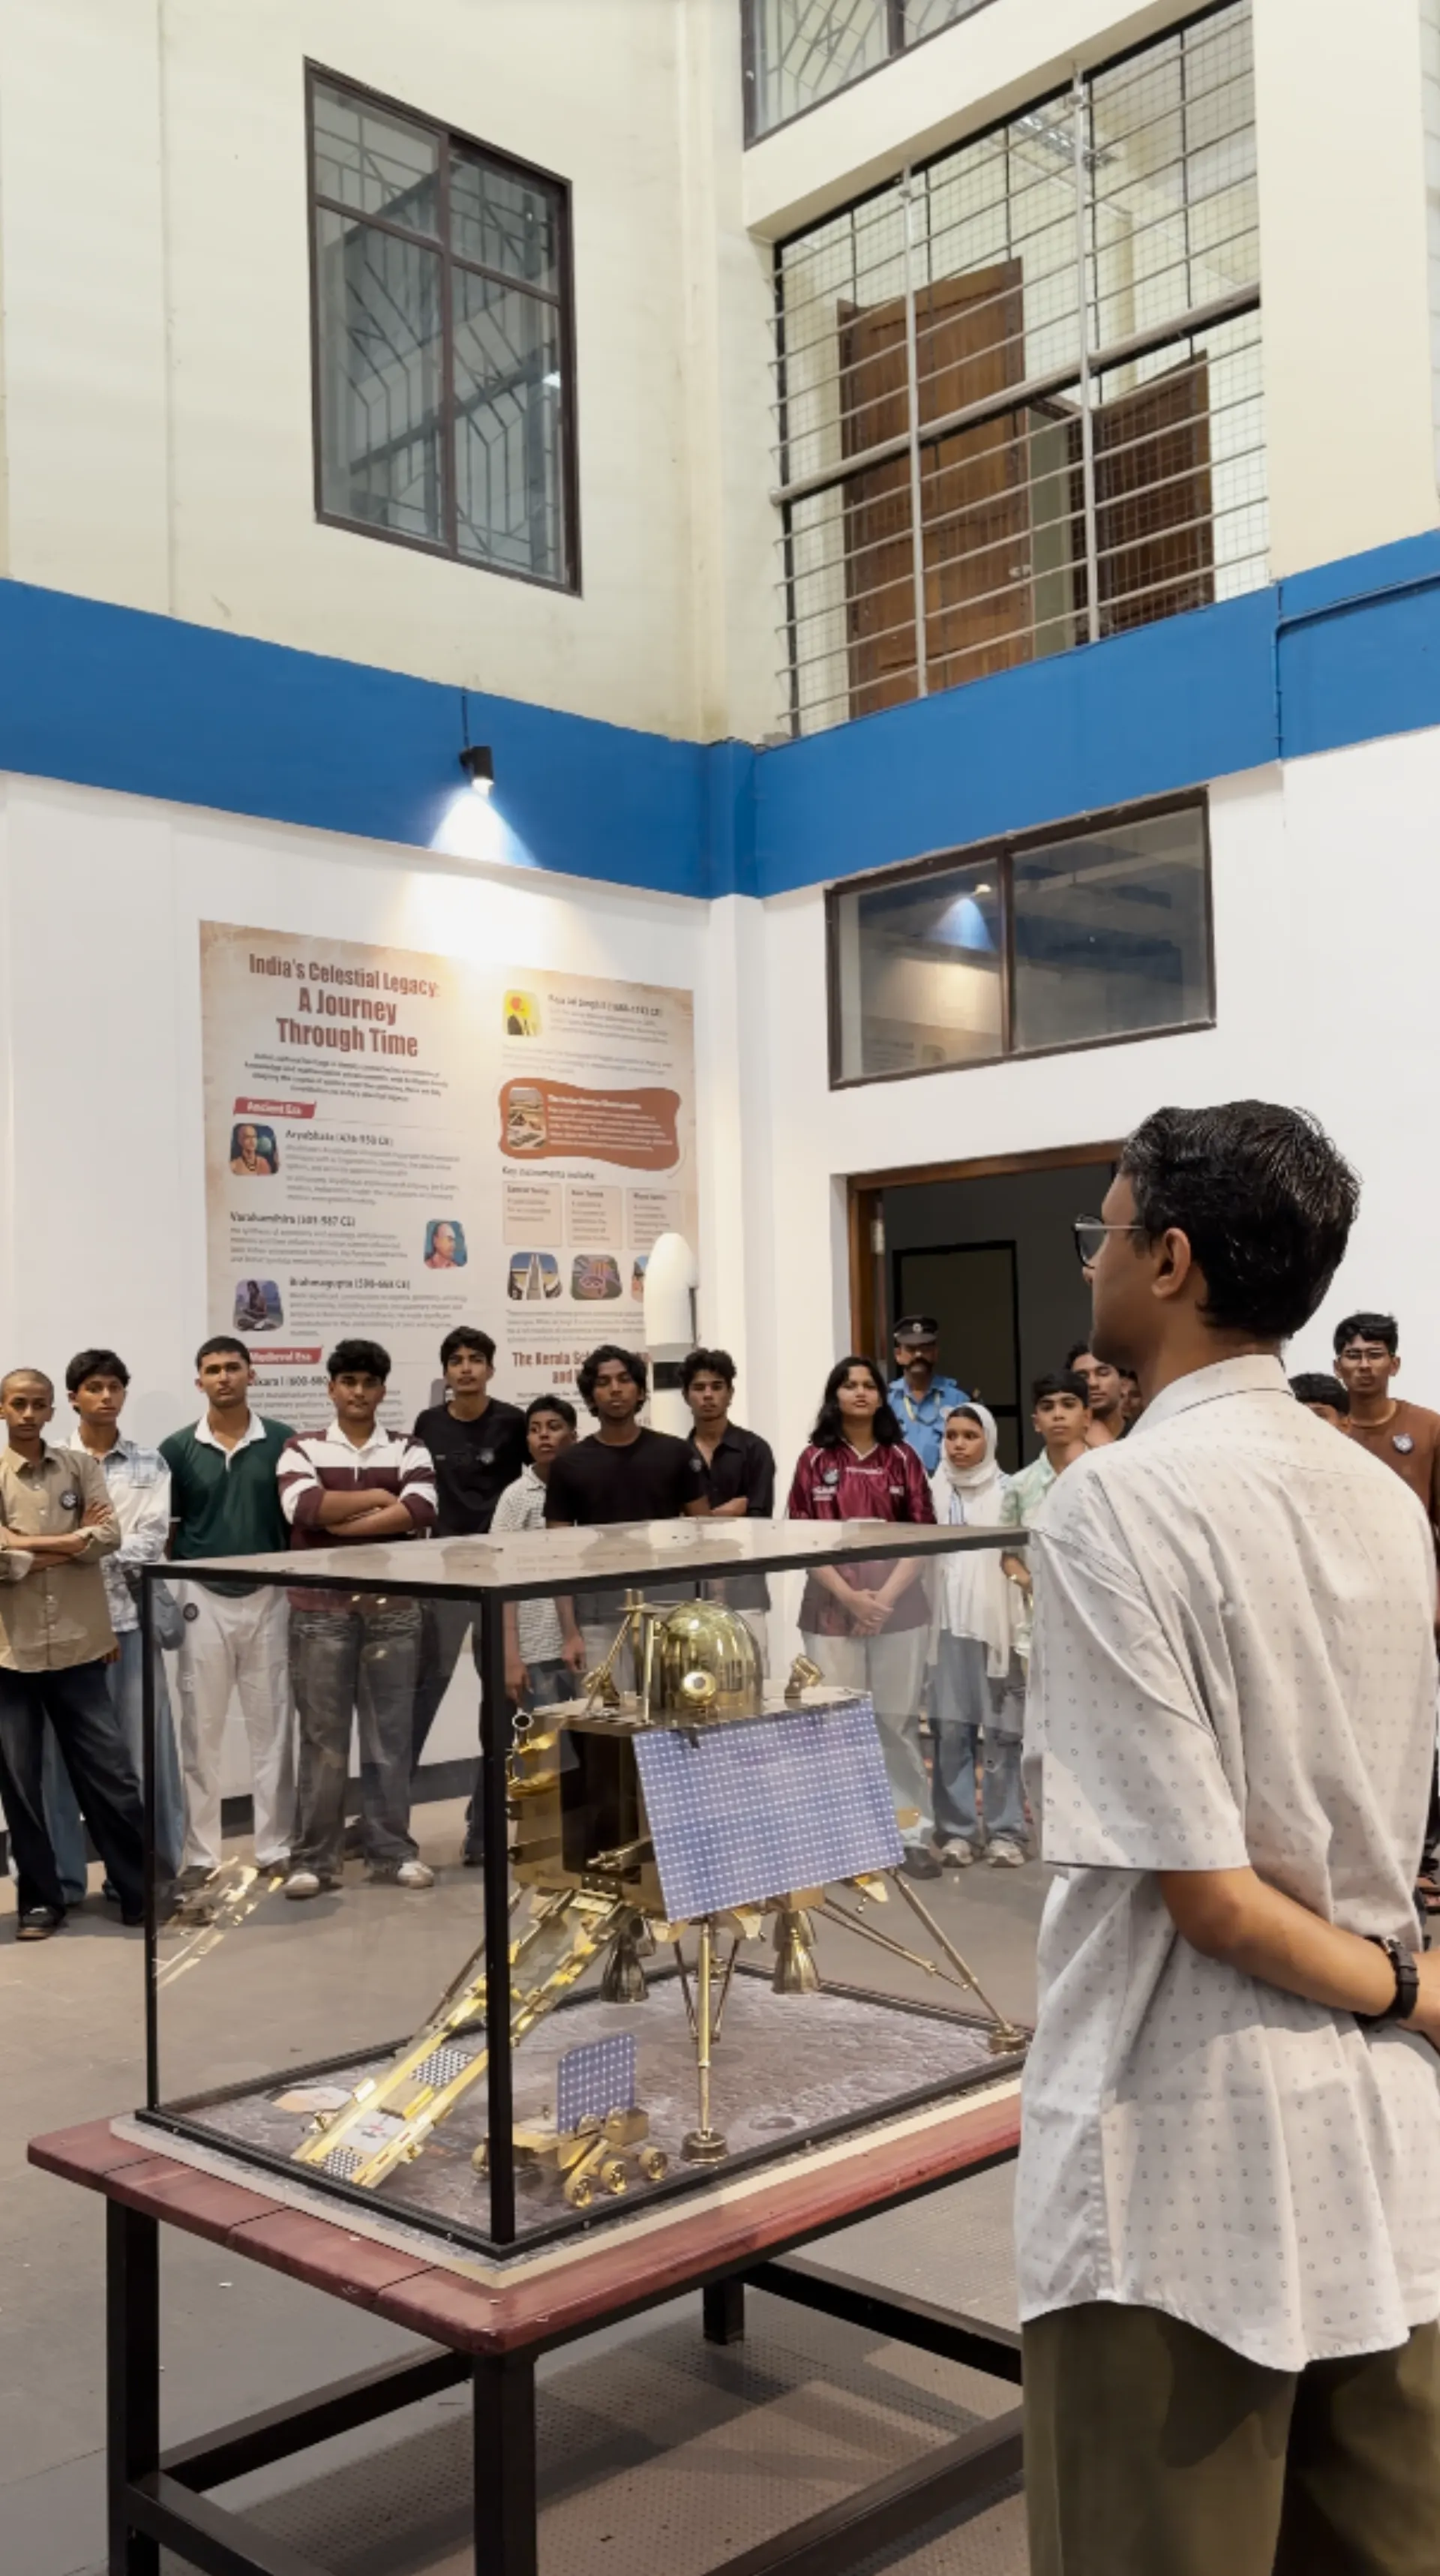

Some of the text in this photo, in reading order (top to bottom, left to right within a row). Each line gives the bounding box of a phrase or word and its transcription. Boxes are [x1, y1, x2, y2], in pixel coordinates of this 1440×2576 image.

[249, 953, 440, 998] India's Celestial Legacy:
[298, 986, 398, 1025] A Journey
[275, 1017, 418, 1057] Through Time
[512, 1351, 532, 1367] The
[536, 1351, 571, 1365] Kerala
[552, 1368, 573, 1384] and
